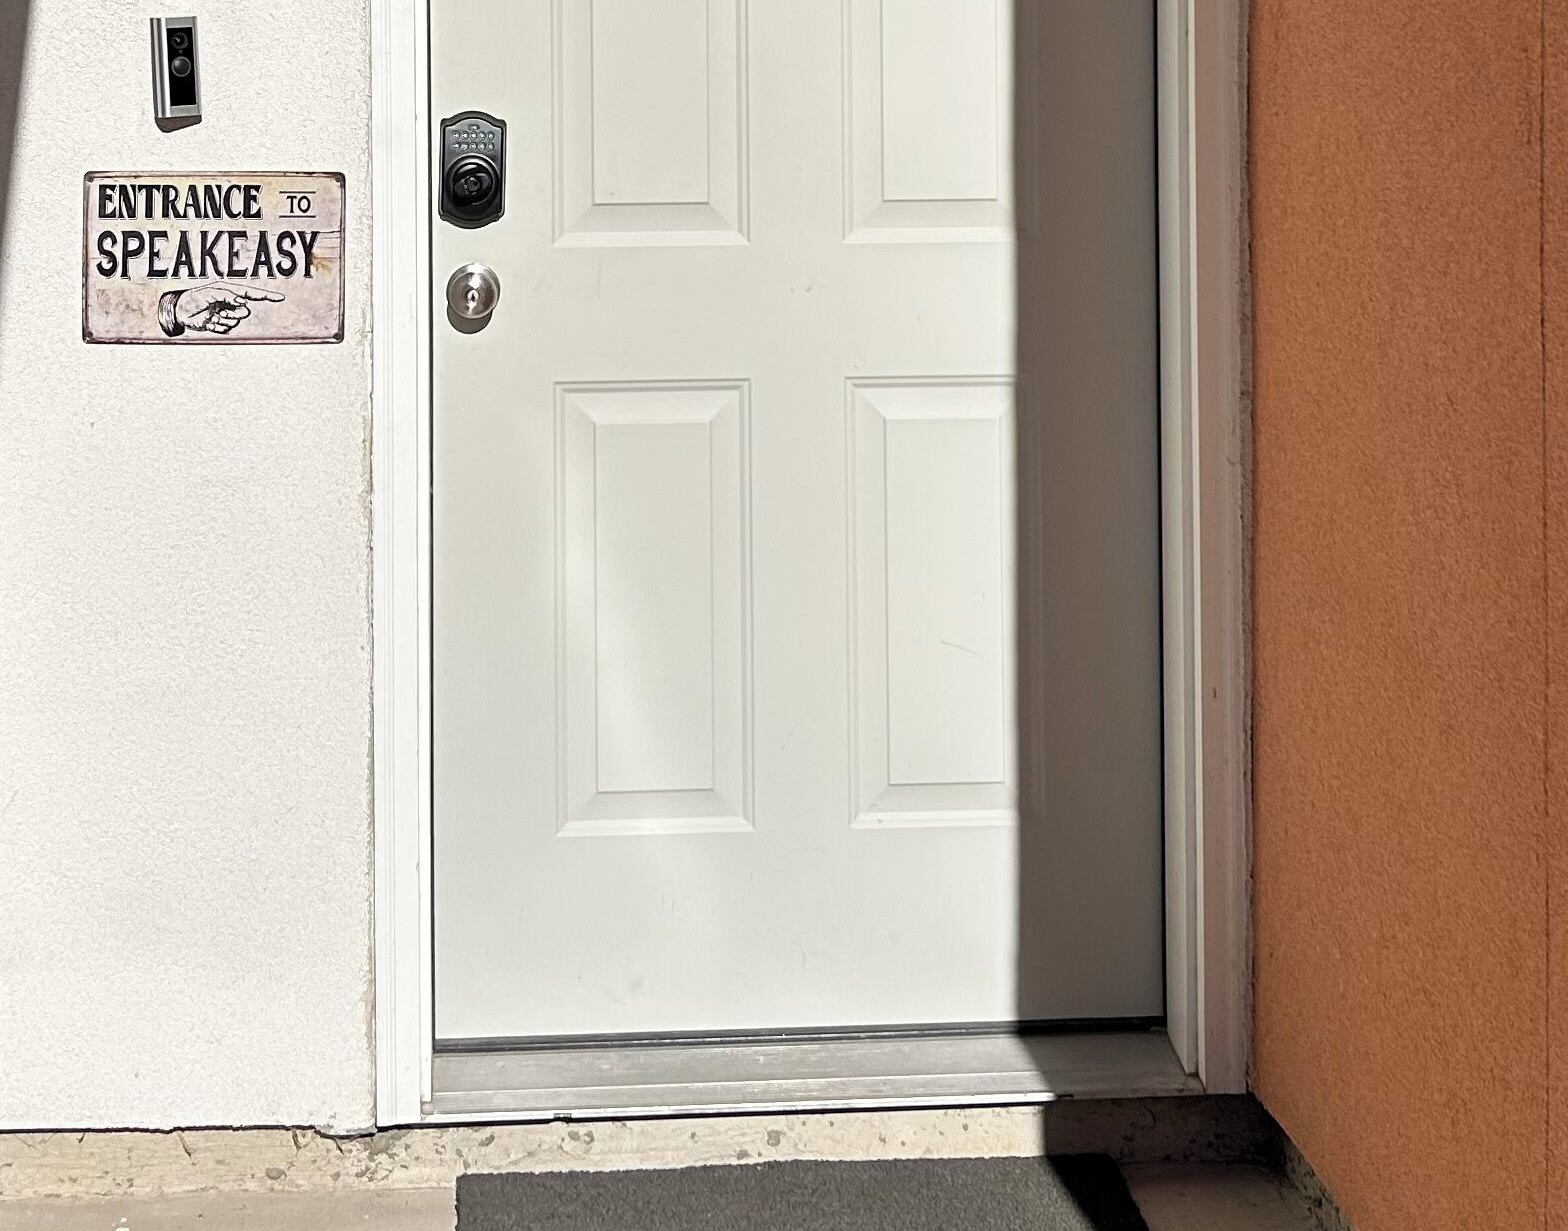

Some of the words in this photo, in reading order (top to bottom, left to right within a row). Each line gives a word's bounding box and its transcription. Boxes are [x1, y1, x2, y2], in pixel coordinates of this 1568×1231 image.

[98, 184, 262, 219] ENTRANCE
[286, 195, 311, 214] TO
[96, 230, 319, 279] SPEAKEASY
